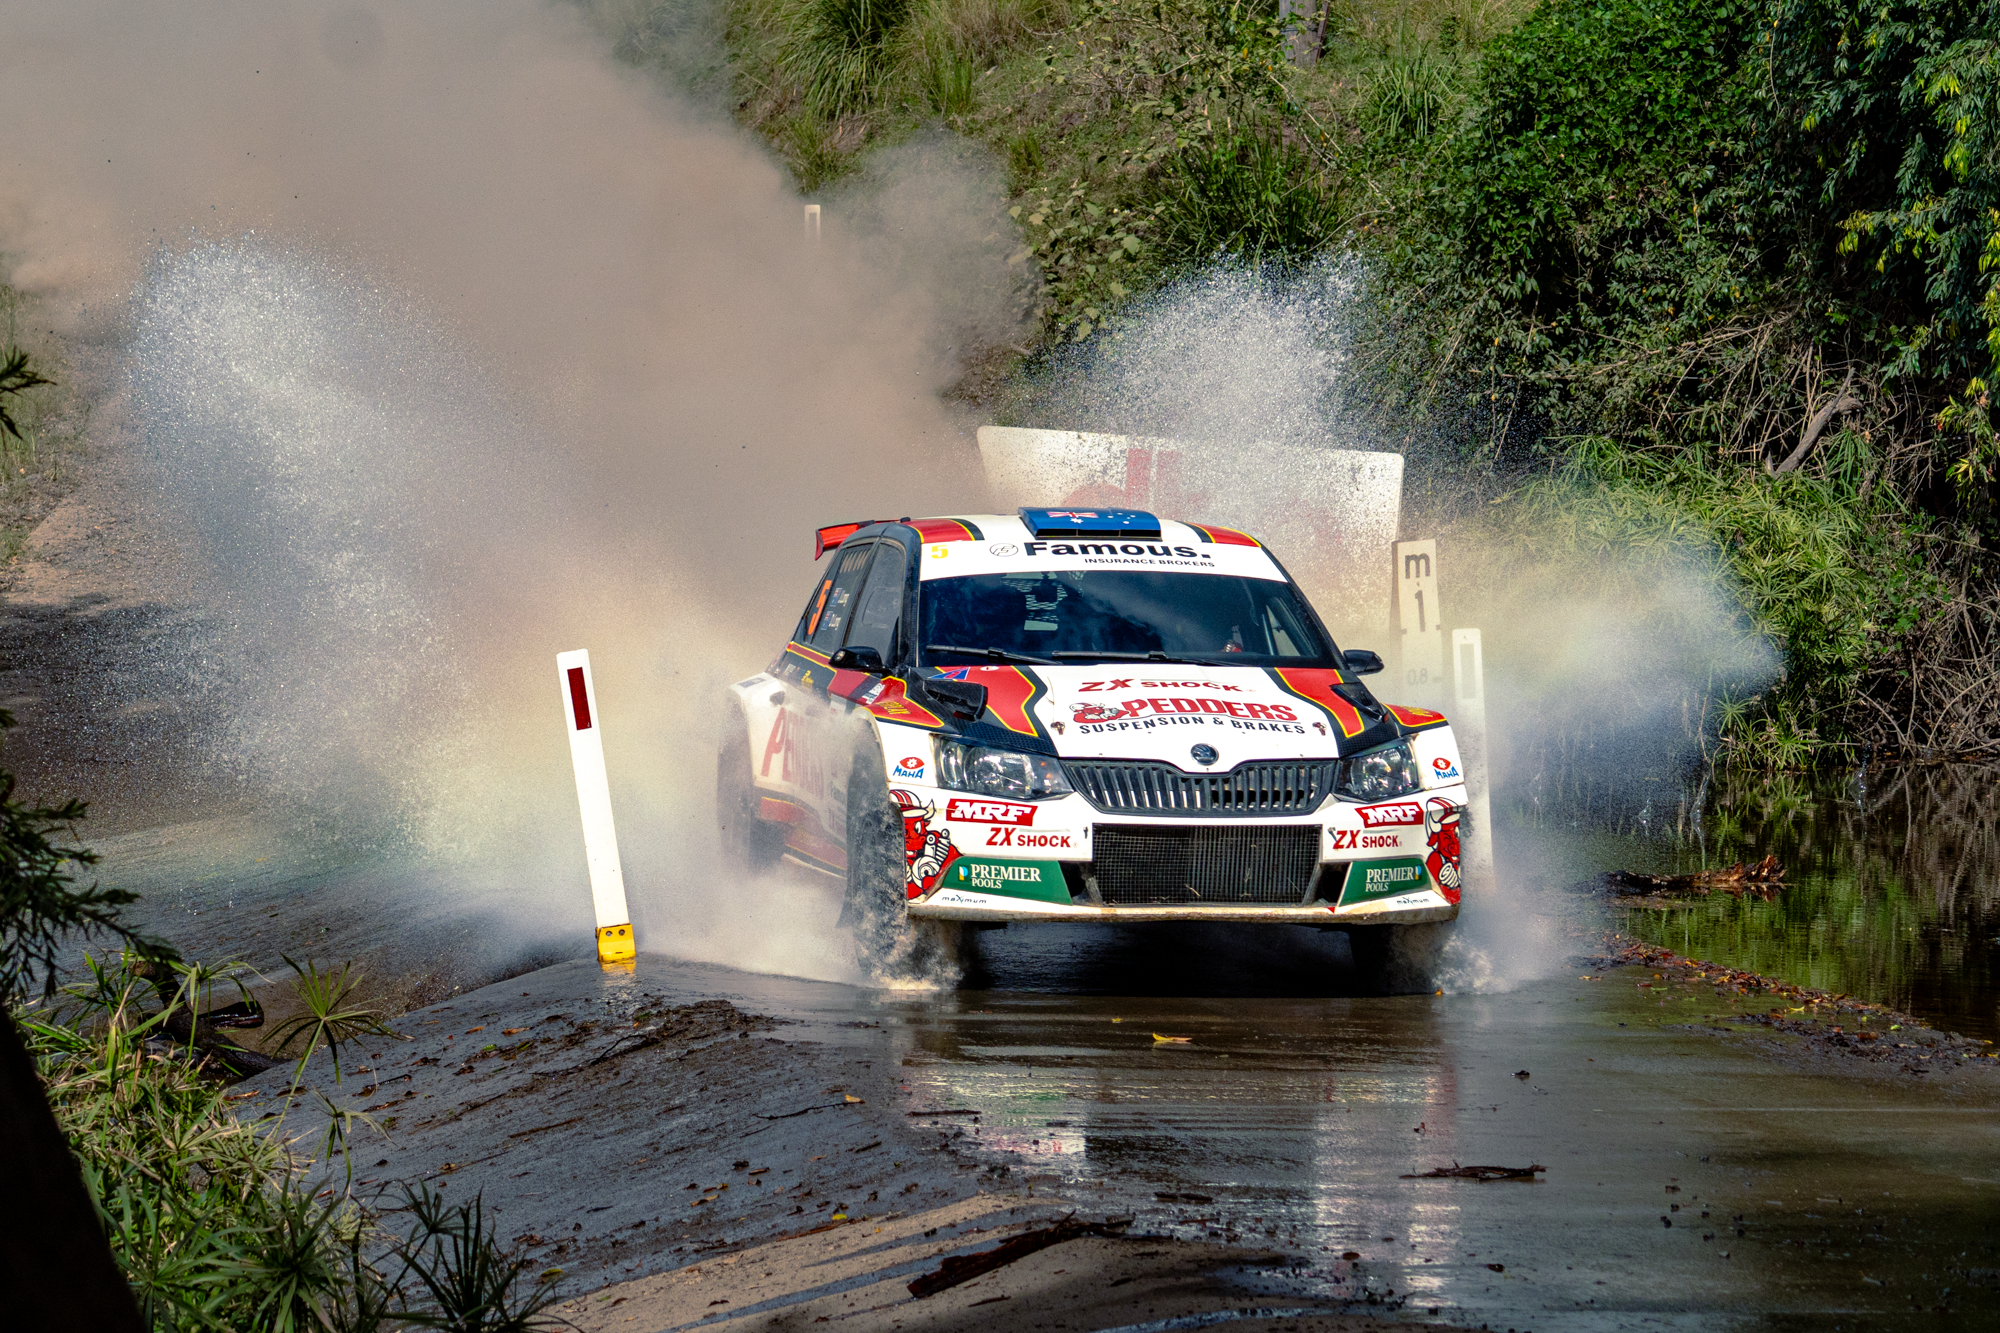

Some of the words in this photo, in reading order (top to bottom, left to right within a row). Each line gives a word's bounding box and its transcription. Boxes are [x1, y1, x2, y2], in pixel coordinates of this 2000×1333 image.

[931, 545, 948, 559] 5
[1023, 542, 1211, 559] Famous.
[1158, 559, 1215, 567] BROKERS
[1404, 553, 1431, 579] m
[1078, 679, 1136, 692] ZX
[1141, 681, 1244, 692] SHOCK
[1120, 698, 1298, 721] PEDDERS
[1079, 716, 1205, 734] SUSPENSION
[1212, 716, 1225, 726] &
[1232, 720, 1306, 734] BRAKES
[893, 765, 925, 779] MAHA
[1434, 766, 1460, 779] MAHA
[951, 801, 1032, 822] MRF
[1362, 804, 1420, 824] MRF
[986, 827, 1017, 846] ZX
[1017, 834, 1071, 848] SHOCK
[1333, 829, 1362, 850] ZX
[1362, 835, 1399, 848] SHOCK
[970, 864, 1041, 882] PREMIER
[1365, 866, 1415, 883] PREMIER
[971, 878, 1002, 889] POOLS
[1365, 882, 1389, 892] POOLS
